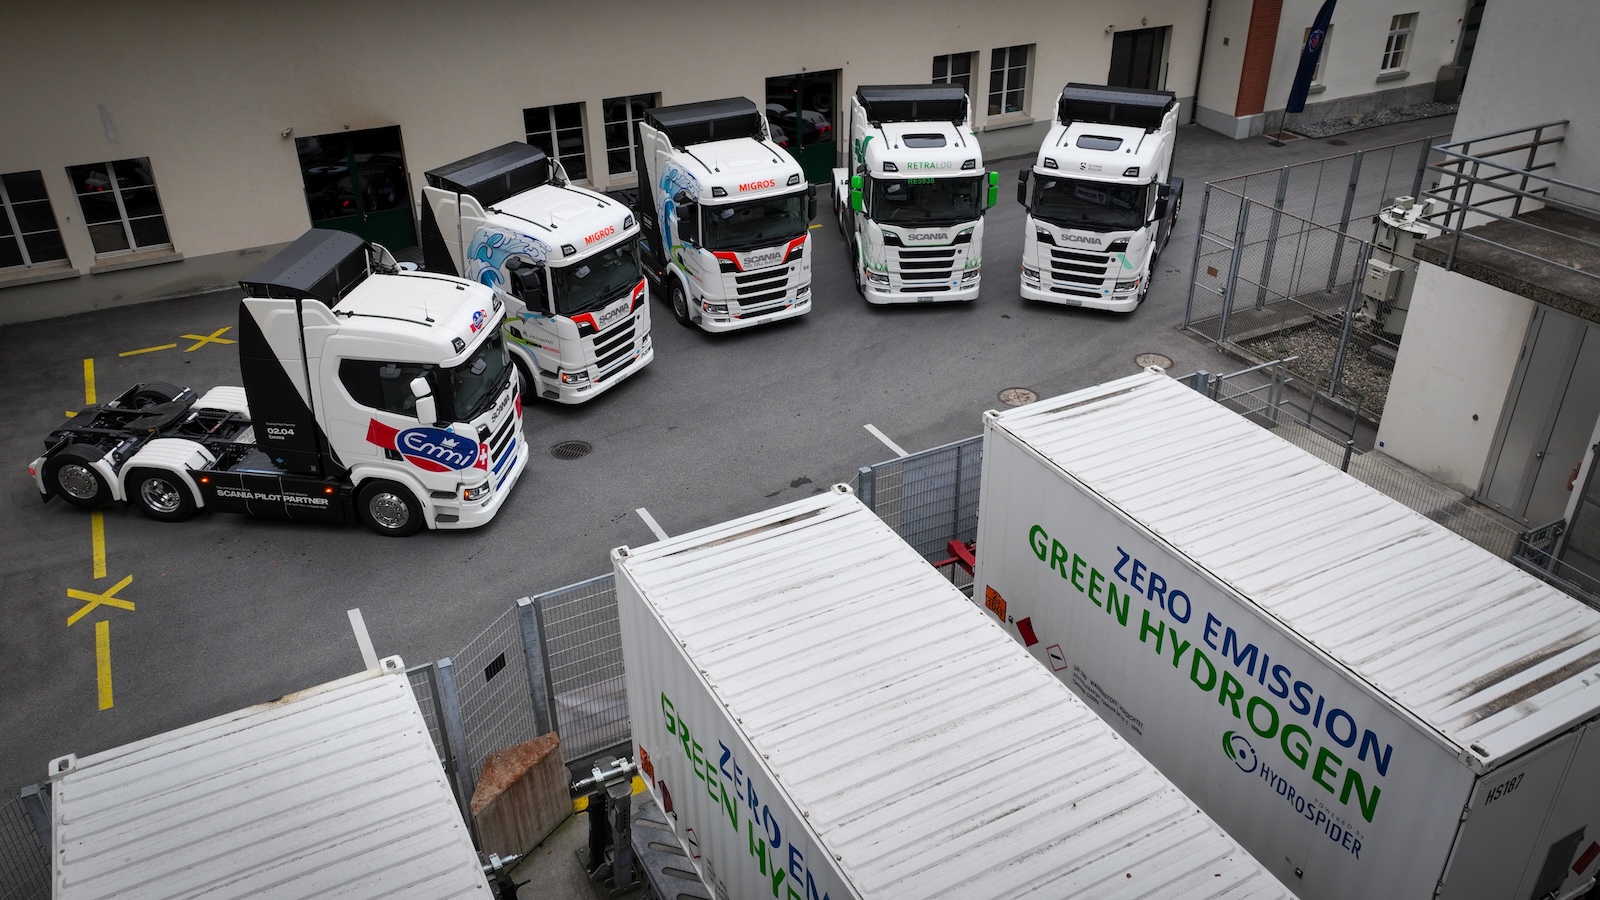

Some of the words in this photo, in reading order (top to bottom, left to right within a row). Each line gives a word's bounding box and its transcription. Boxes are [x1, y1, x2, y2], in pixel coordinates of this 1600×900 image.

[907, 161, 952, 170] RETRALOG
[739, 179, 775, 192] MIGROS
[584, 225, 615, 246] MIGROS
[908, 232, 949, 242] SCANIA
[1061, 233, 1102, 246] SCANIA
[743, 252, 782, 265] SCANIA
[598, 302, 630, 324] SCANIA
[491, 394, 510, 422] SCANIA
[267, 427, 295, 436] 02.04
[403, 432, 475, 466] Emmi
[217, 489, 254, 499] SCANIA
[254, 492, 281, 502] PILOT
[283, 496, 329, 506] PARTNER
[1029, 524, 1130, 627] GREEN
[1139, 608, 1381, 823] HYDROGEN
[1113, 546, 1192, 624] ZERO
[1203, 612, 1394, 777] EMISSION
[661, 692, 738, 833] GREEN
[718, 739, 781, 848] ZERO
[1485, 772, 1525, 806] HS187
[1260, 762, 1362, 860] HYDROSPIDER
[1314, 798, 1353, 830] POWERED
[1355, 830, 1365, 840] BY
